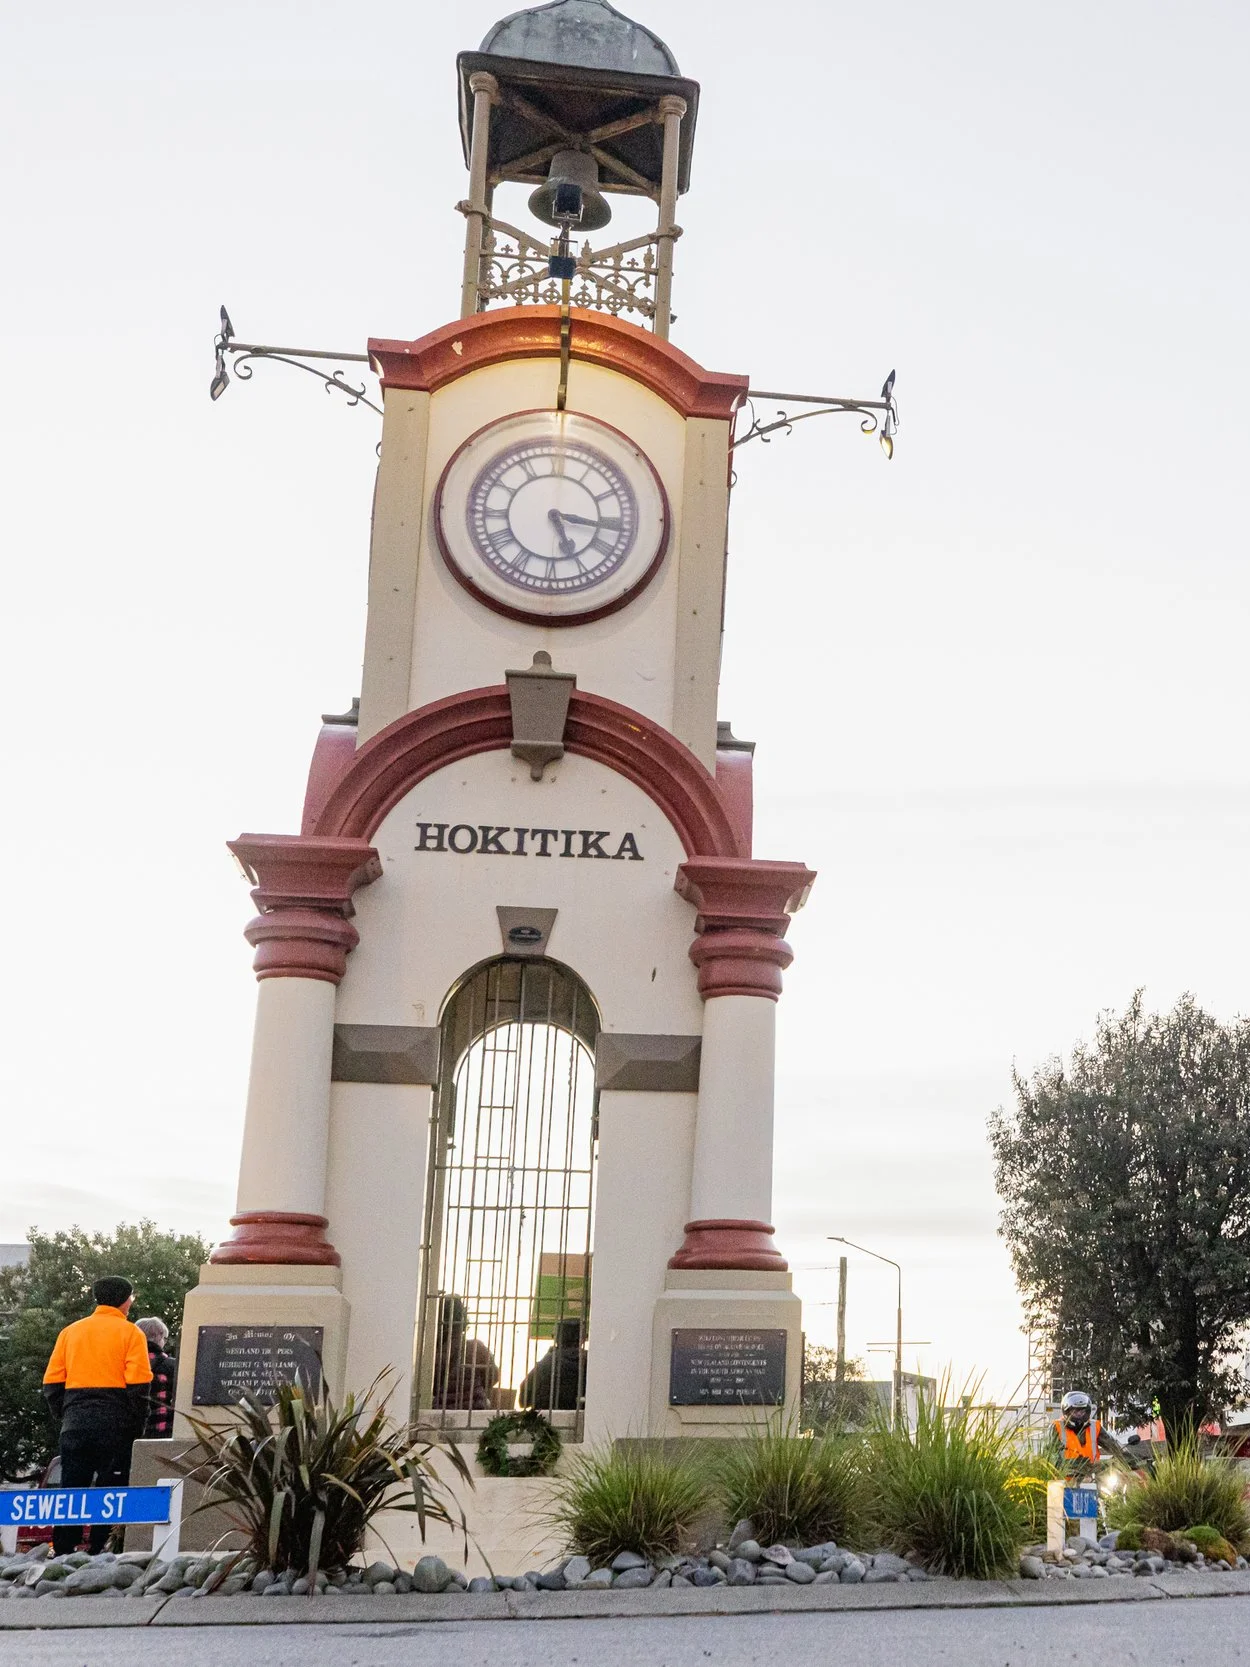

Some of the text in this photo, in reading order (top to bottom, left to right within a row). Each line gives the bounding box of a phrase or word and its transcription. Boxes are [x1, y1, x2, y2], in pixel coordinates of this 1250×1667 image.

[414, 822, 645, 861] HOKITIKA
[11, 1492, 128, 1521] SEWELL ST
